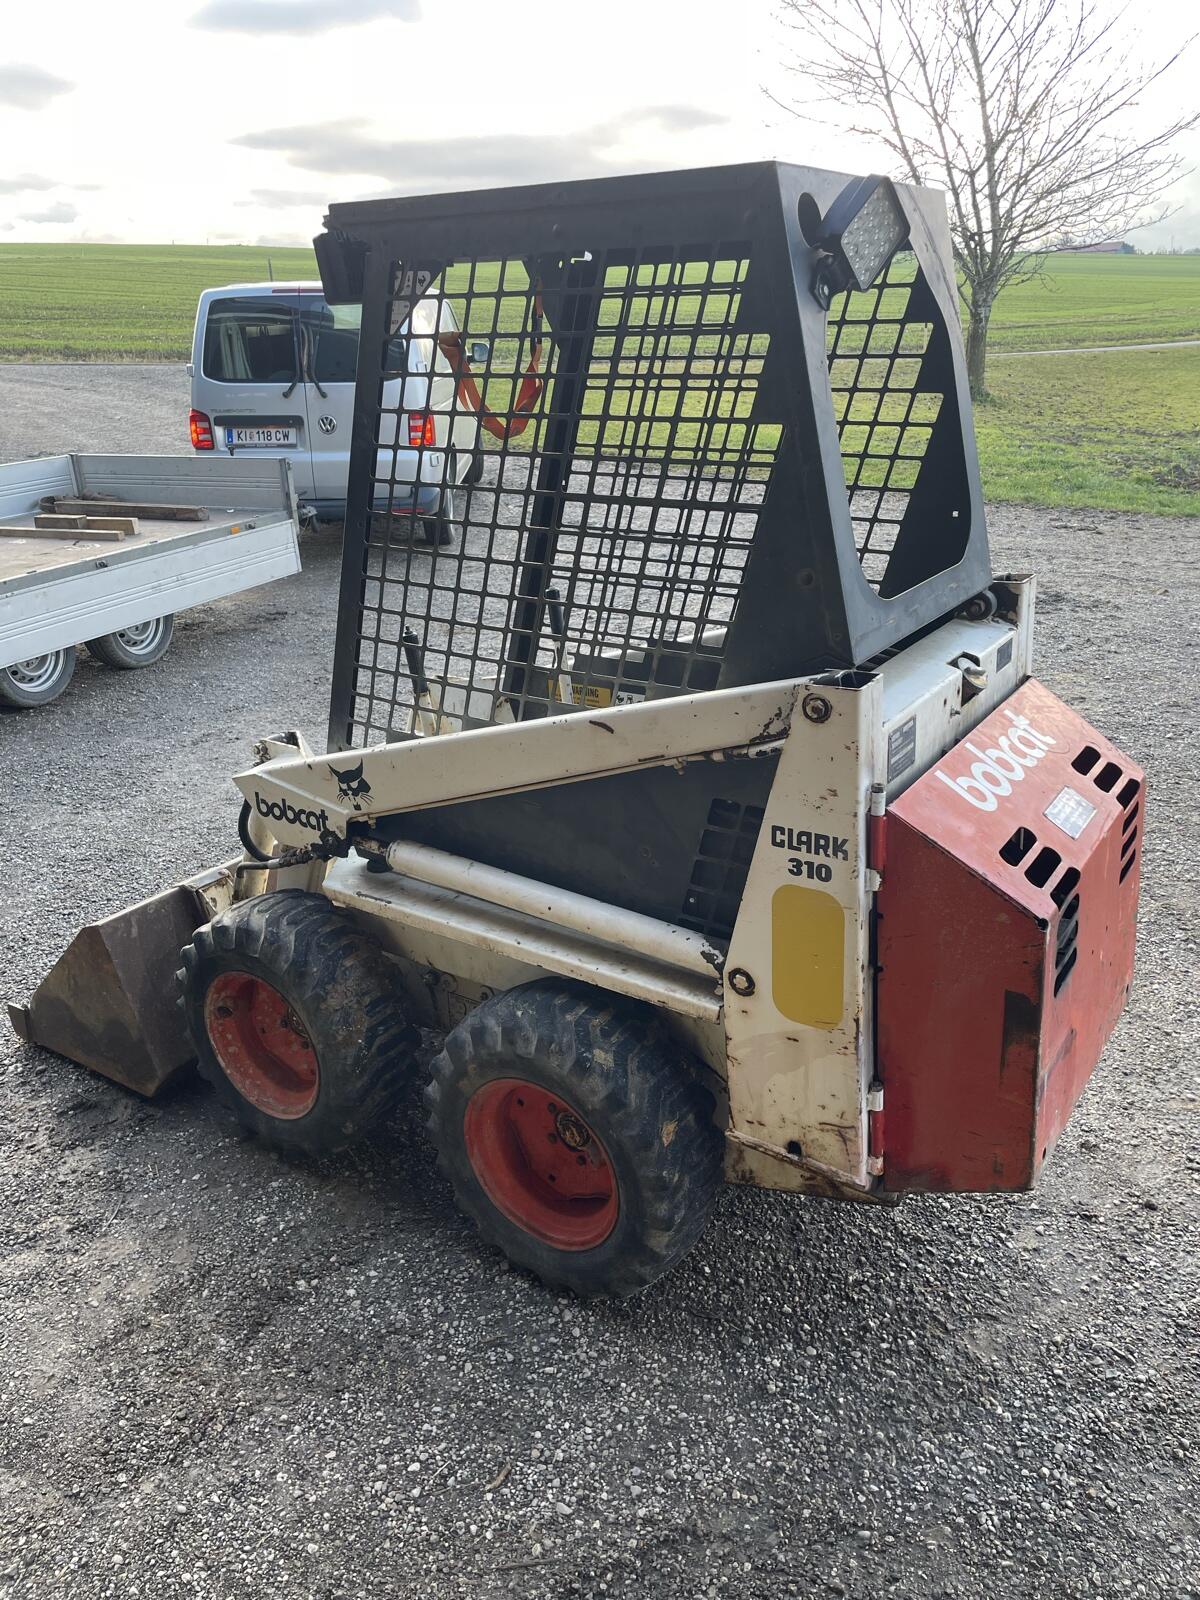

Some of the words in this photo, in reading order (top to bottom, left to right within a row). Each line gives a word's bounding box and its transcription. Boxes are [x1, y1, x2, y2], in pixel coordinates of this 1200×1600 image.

[237, 430, 248, 442] KI
[256, 430, 273, 442] 118
[275, 430, 290, 442] CW
[319, 416, 336, 434] VW
[934, 708, 1057, 812] bobcat
[254, 791, 329, 831] bobcat
[771, 825, 849, 861] CLARK
[787, 857, 832, 883] 310
